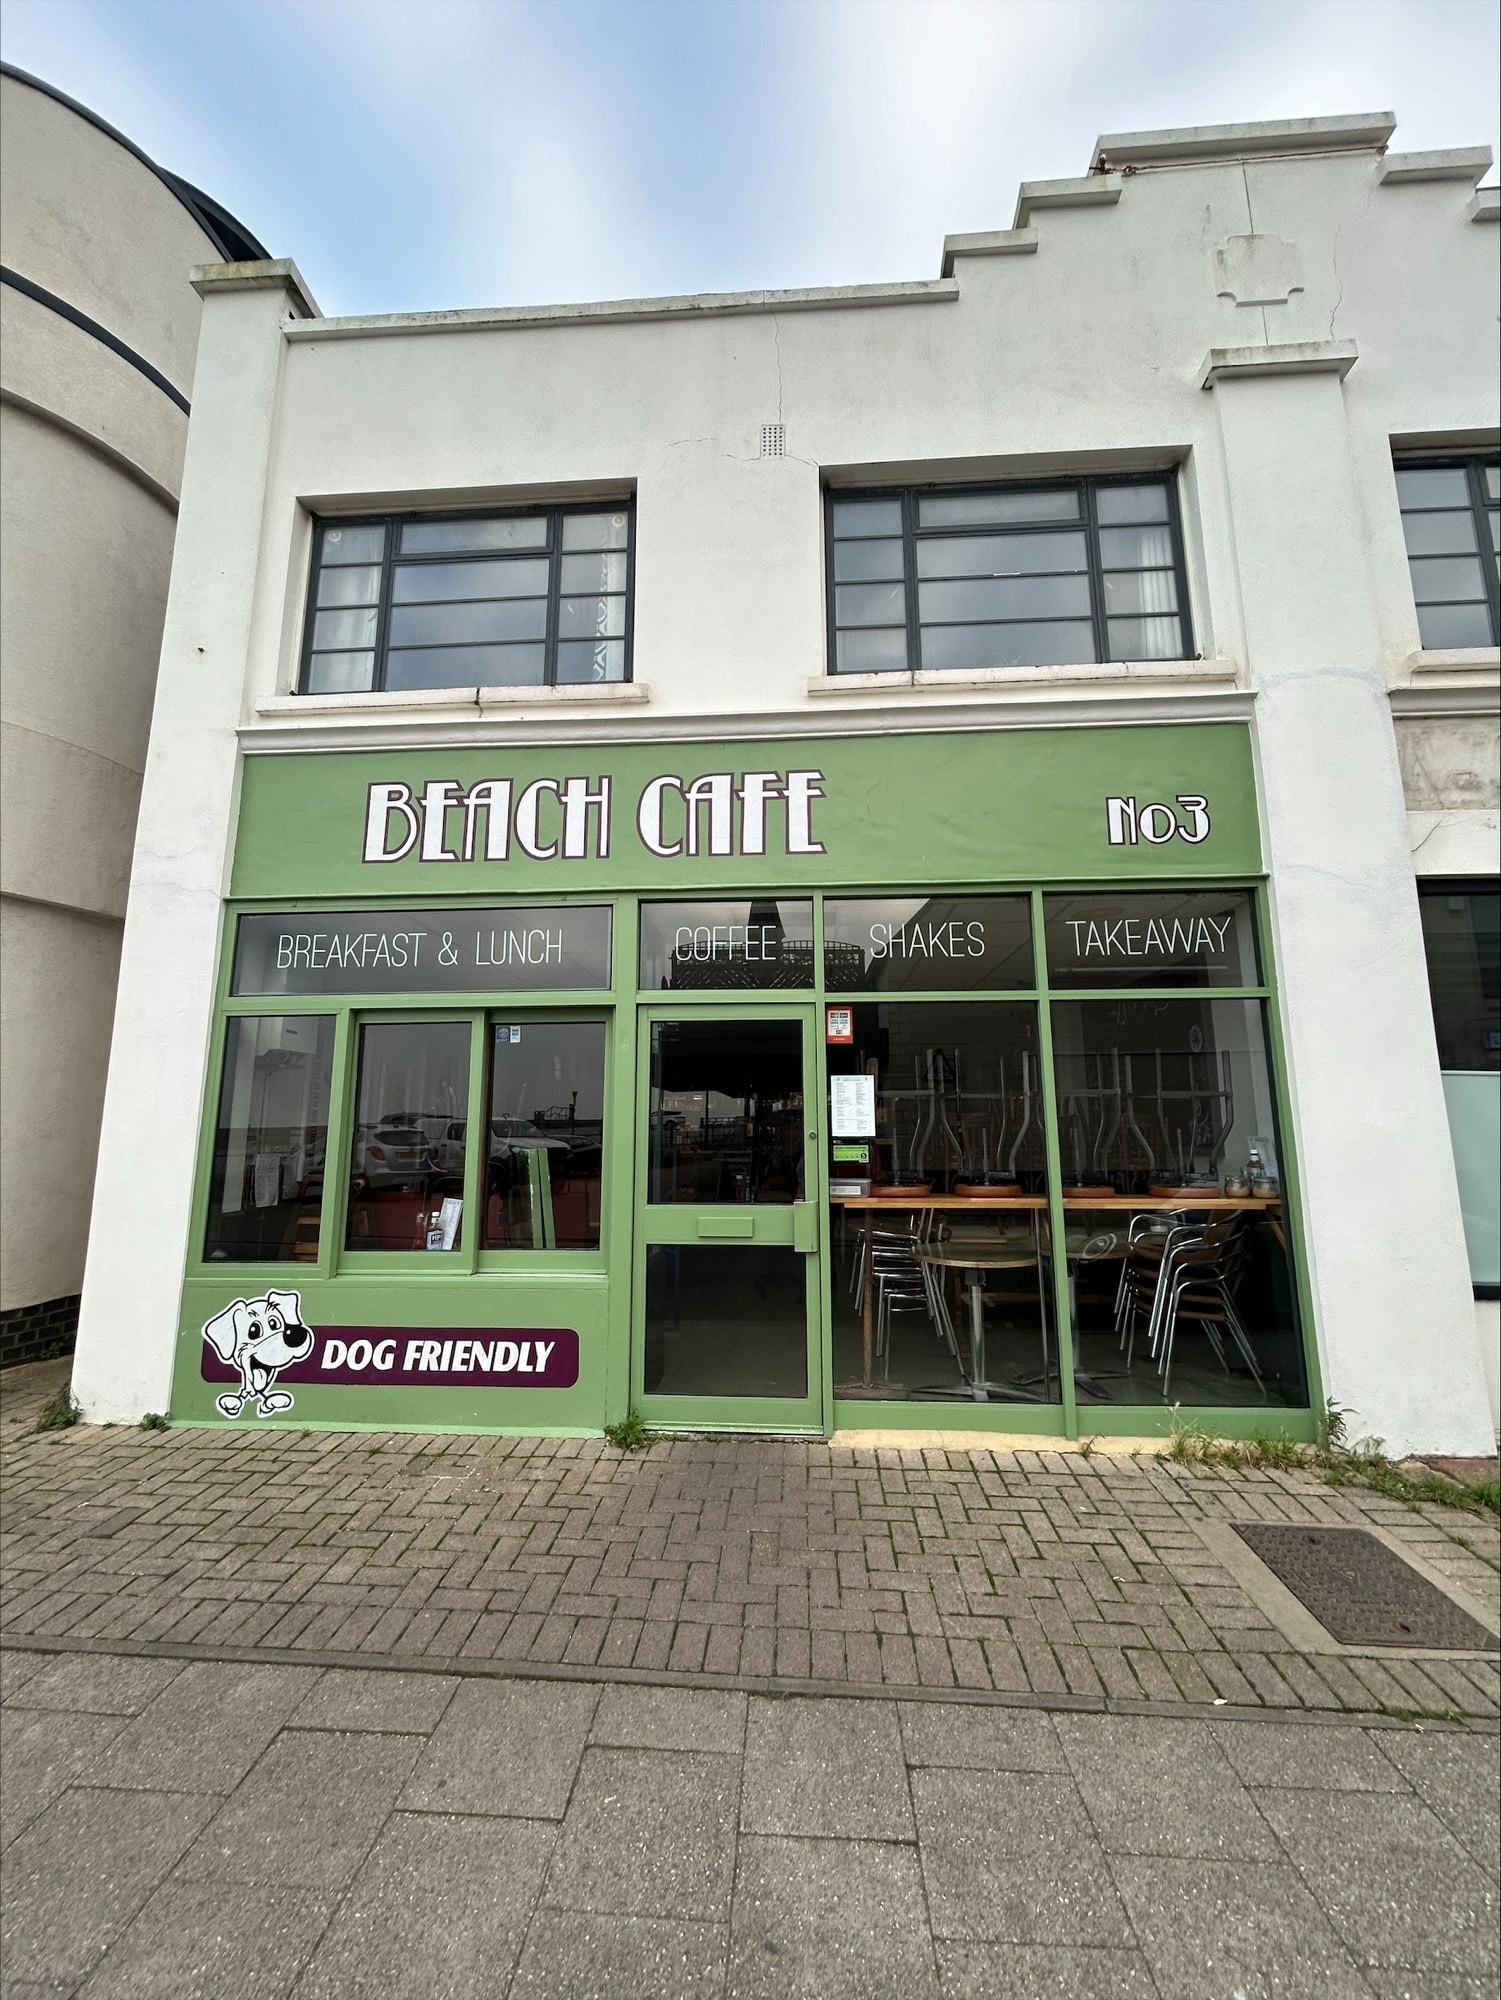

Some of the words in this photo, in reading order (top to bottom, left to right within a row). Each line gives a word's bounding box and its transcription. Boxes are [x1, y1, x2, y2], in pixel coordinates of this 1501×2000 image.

[361, 775, 614, 864] BEACH
[636, 769, 828, 858] CAFE
[1105, 794, 1211, 846] No3
[275, 932, 427, 970] BREAKFAST
[437, 932, 459, 967] &
[474, 929, 563, 967] LUNCH
[674, 925, 777, 962] COFFEE
[869, 921, 985, 959] SHAKES
[1065, 916, 1232, 957] TAKEAWAY
[321, 1339, 397, 1371] DOG
[402, 1340, 555, 1373] FRIENDLY
